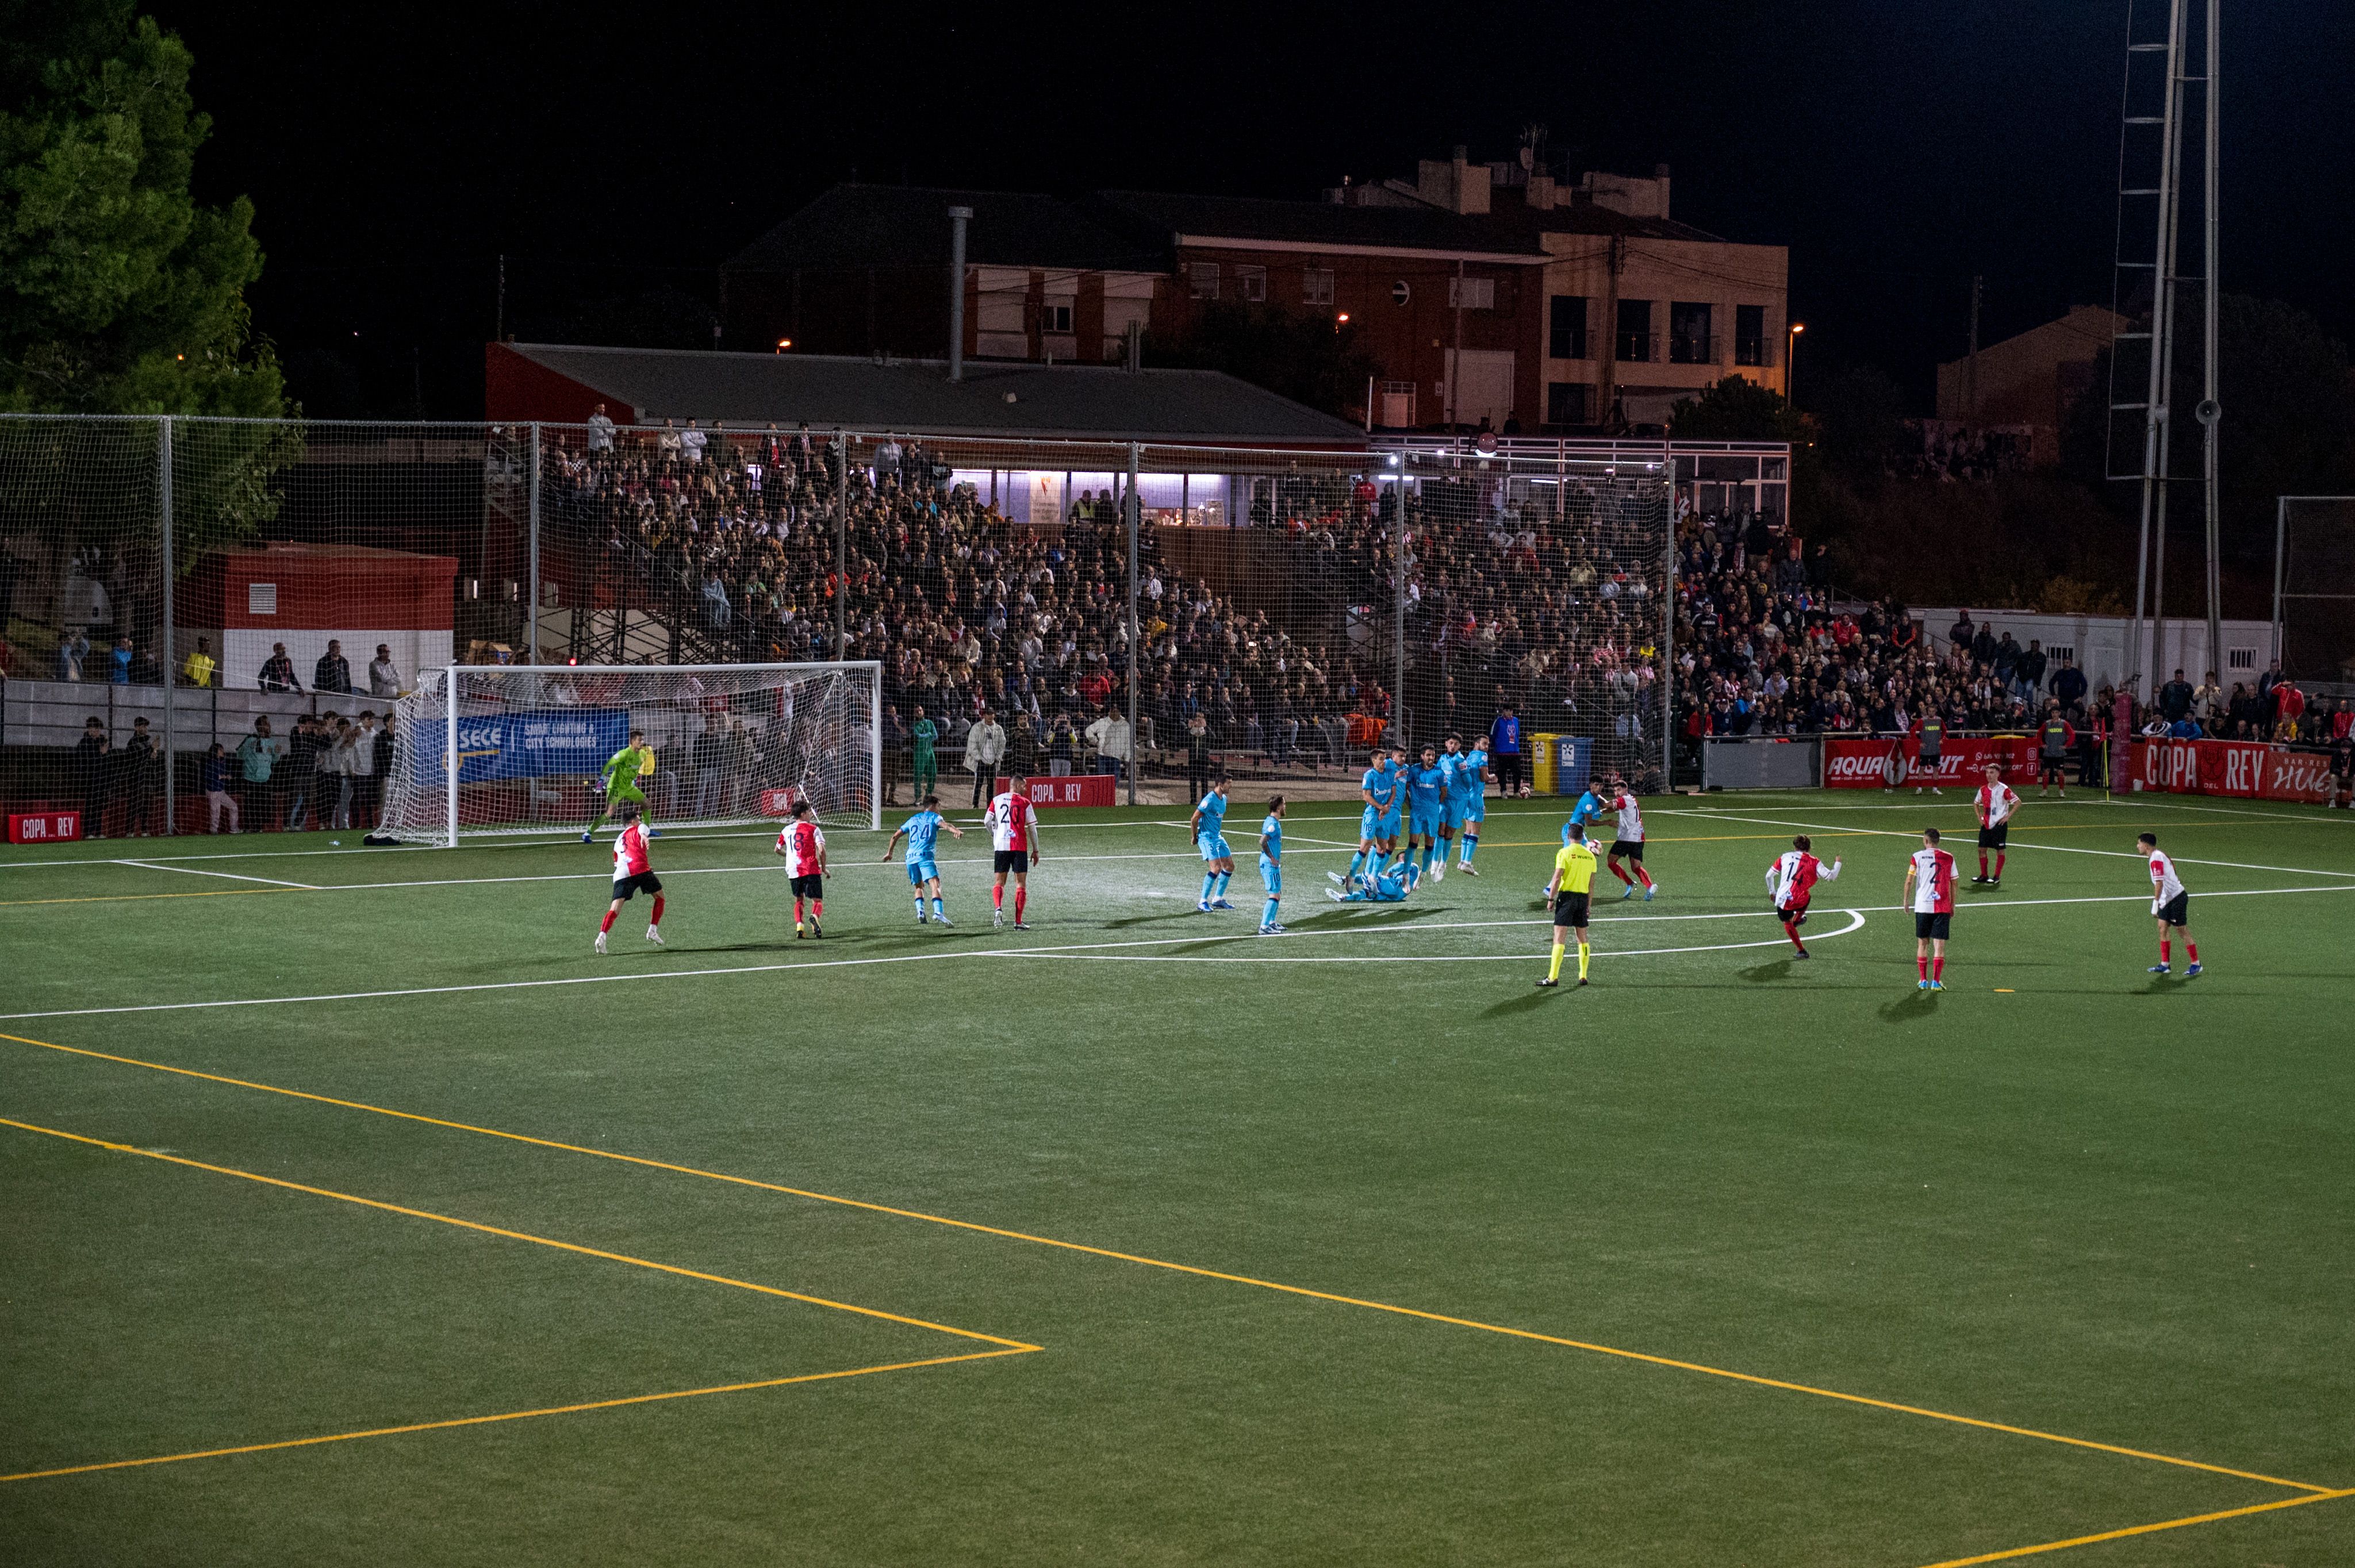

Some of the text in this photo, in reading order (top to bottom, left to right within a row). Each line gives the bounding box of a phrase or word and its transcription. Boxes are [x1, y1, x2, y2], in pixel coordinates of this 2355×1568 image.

[459, 728, 501, 748] SECE
[552, 723, 586, 734] LIGHTING
[525, 737, 543, 749] CITY
[1827, 756, 1884, 776] AQUA
[2146, 745, 2197, 788] COPA
[2226, 749, 2264, 791] REY
[1031, 785, 1053, 802] COPA
[1065, 783, 1081, 801] REY
[1000, 804, 1020, 825] 20
[23, 818, 45, 839] COPA
[58, 817, 74, 837] REY
[910, 824, 930, 843] 24
[1366, 823, 1372, 832] 16
[620, 836, 628, 853] 3
[788, 832, 804, 853] 18
[1209, 843, 1214, 851] 3
[1273, 873, 1280, 882] 10
[1786, 862, 1804, 885] 14
[1930, 862, 1942, 884] 2
